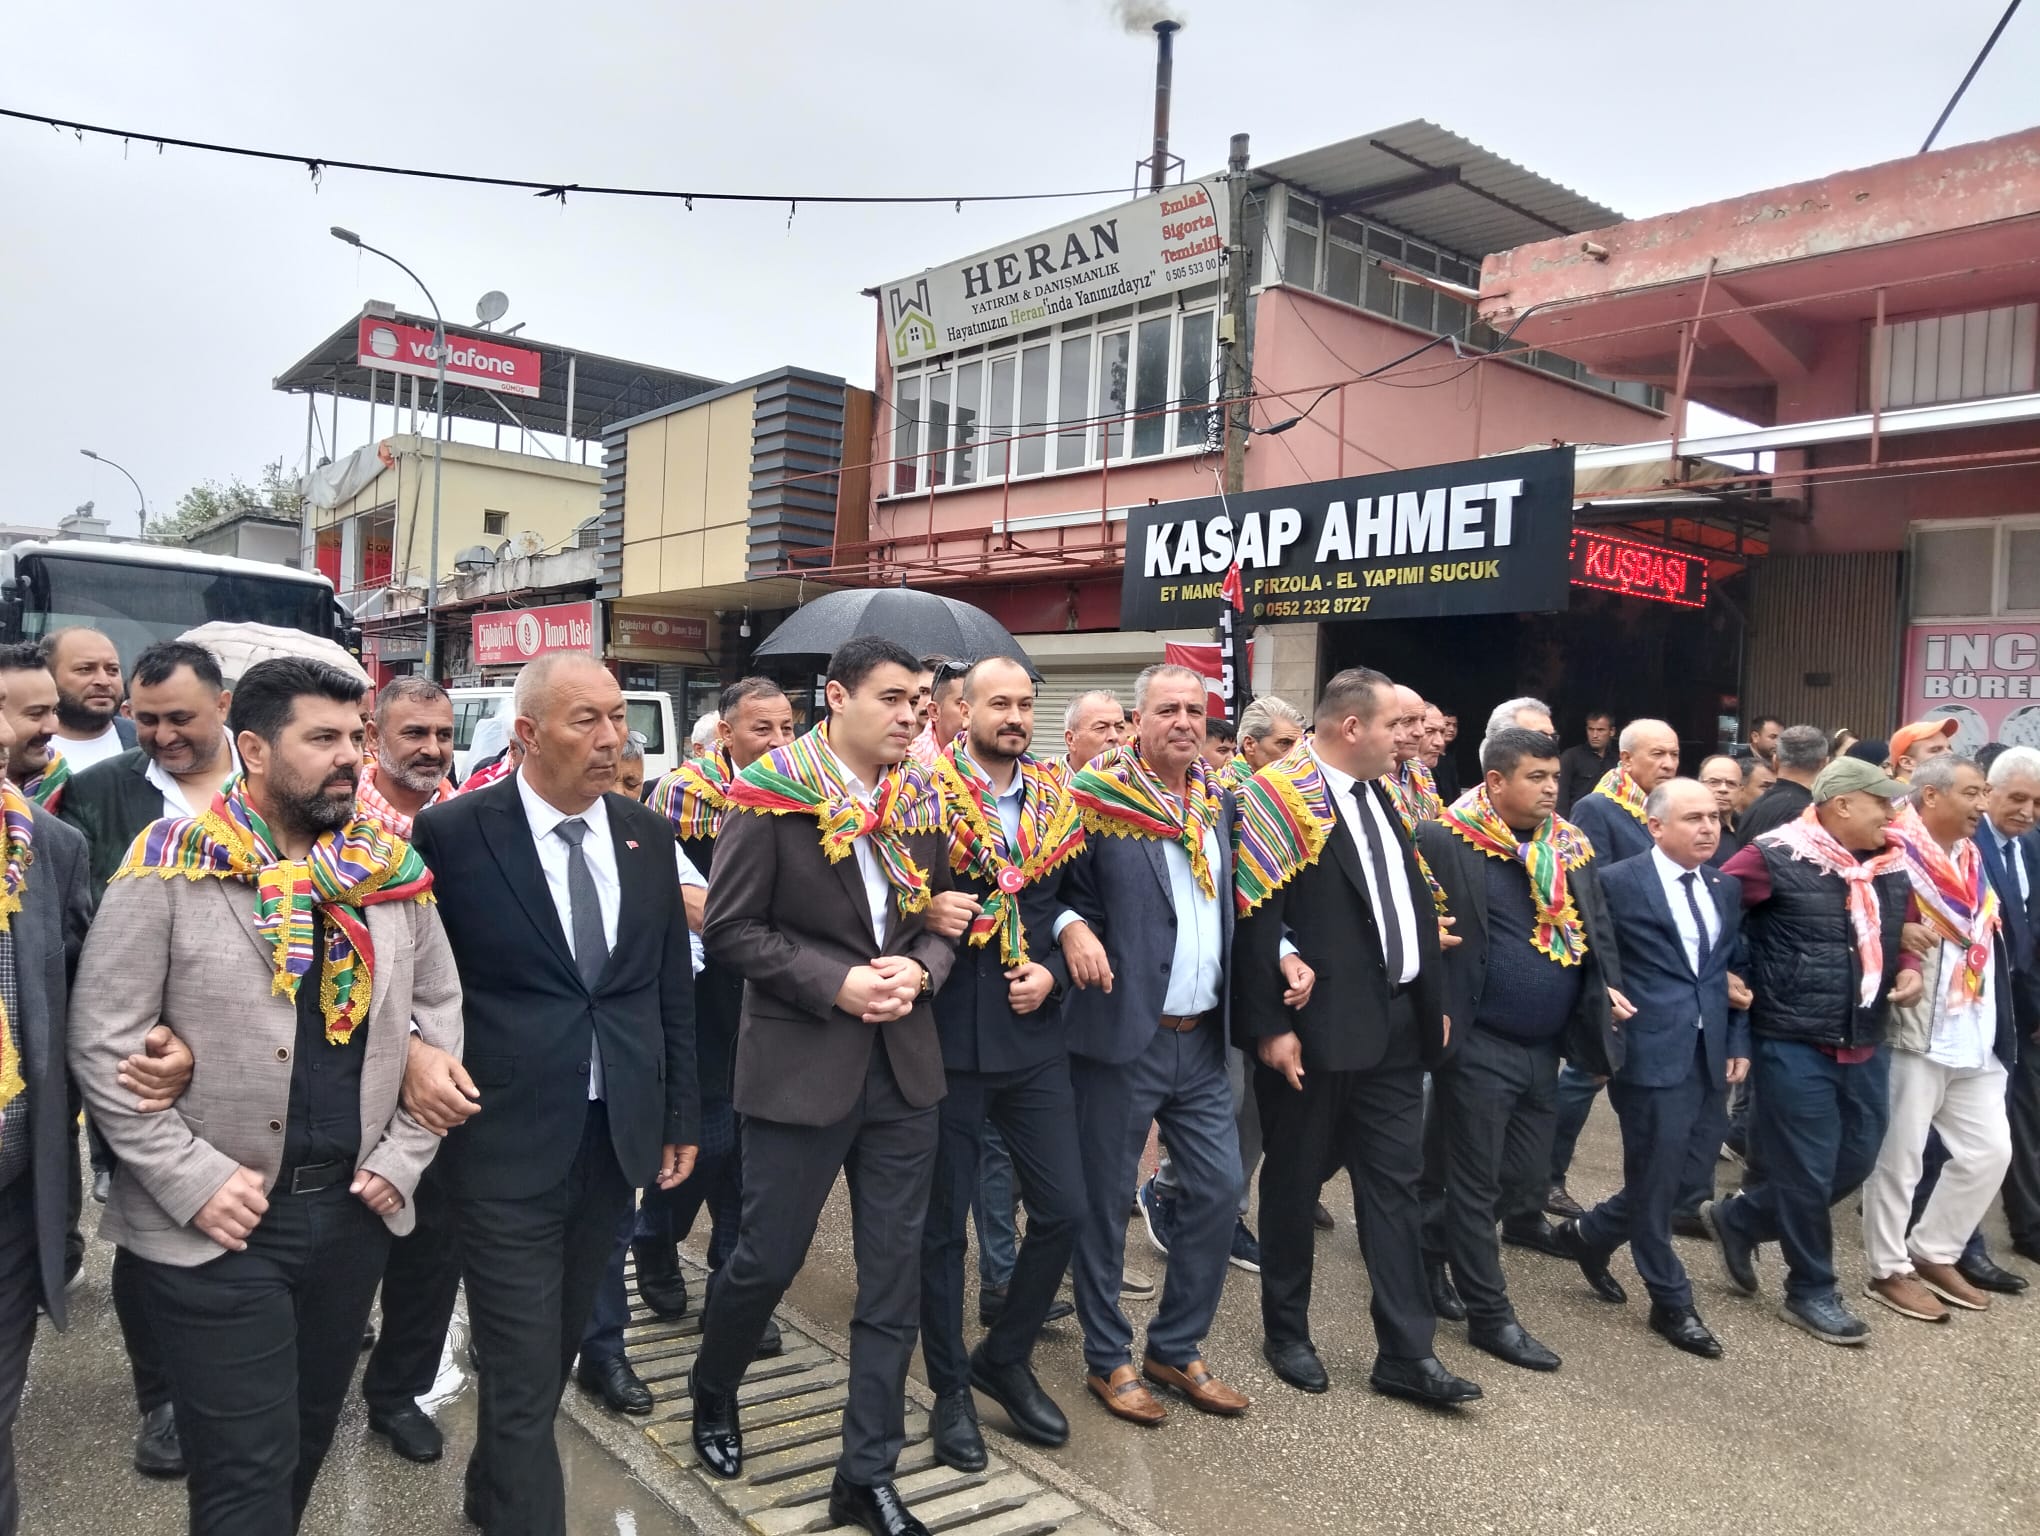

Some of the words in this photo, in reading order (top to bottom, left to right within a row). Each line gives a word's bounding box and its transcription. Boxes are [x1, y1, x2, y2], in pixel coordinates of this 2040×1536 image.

[1160, 190, 1207, 217] Emlak
[1162, 215, 1215, 241] Sigorta
[961, 218, 1120, 299] HERAN
[1161, 234, 1225, 264] Temizlik
[1165, 271, 1172, 282] 0
[1172, 266, 1187, 280] 505
[1188, 262, 1204, 276] 533
[1205, 258, 1217, 271] 00
[971, 292, 1020, 315] YATIRIM
[1023, 289, 1032, 300] &
[1034, 262, 1120, 297] DANIŞMANLIK
[947, 316, 1008, 342] Hayatınızın
[1143, 507, 1303, 578] KASAP
[1315, 478, 1524, 563] AHMET
[1160, 586, 1178, 602] ET
[1181, 582, 1226, 601] MANG
[1336, 572, 1358, 590] EL
[1362, 566, 1425, 588] YAPIMI
[1429, 559, 1501, 583] SUCUK
[1583, 540, 1688, 601] KUŞBAŞI
[1266, 599, 1300, 617] 0552
[1303, 599, 1330, 616] 232
[1333, 595, 1371, 614] 8727
[544, 617, 568, 648] Ömer
[568, 618, 591, 646] Usta
[1926, 632, 2040, 671] iNC
